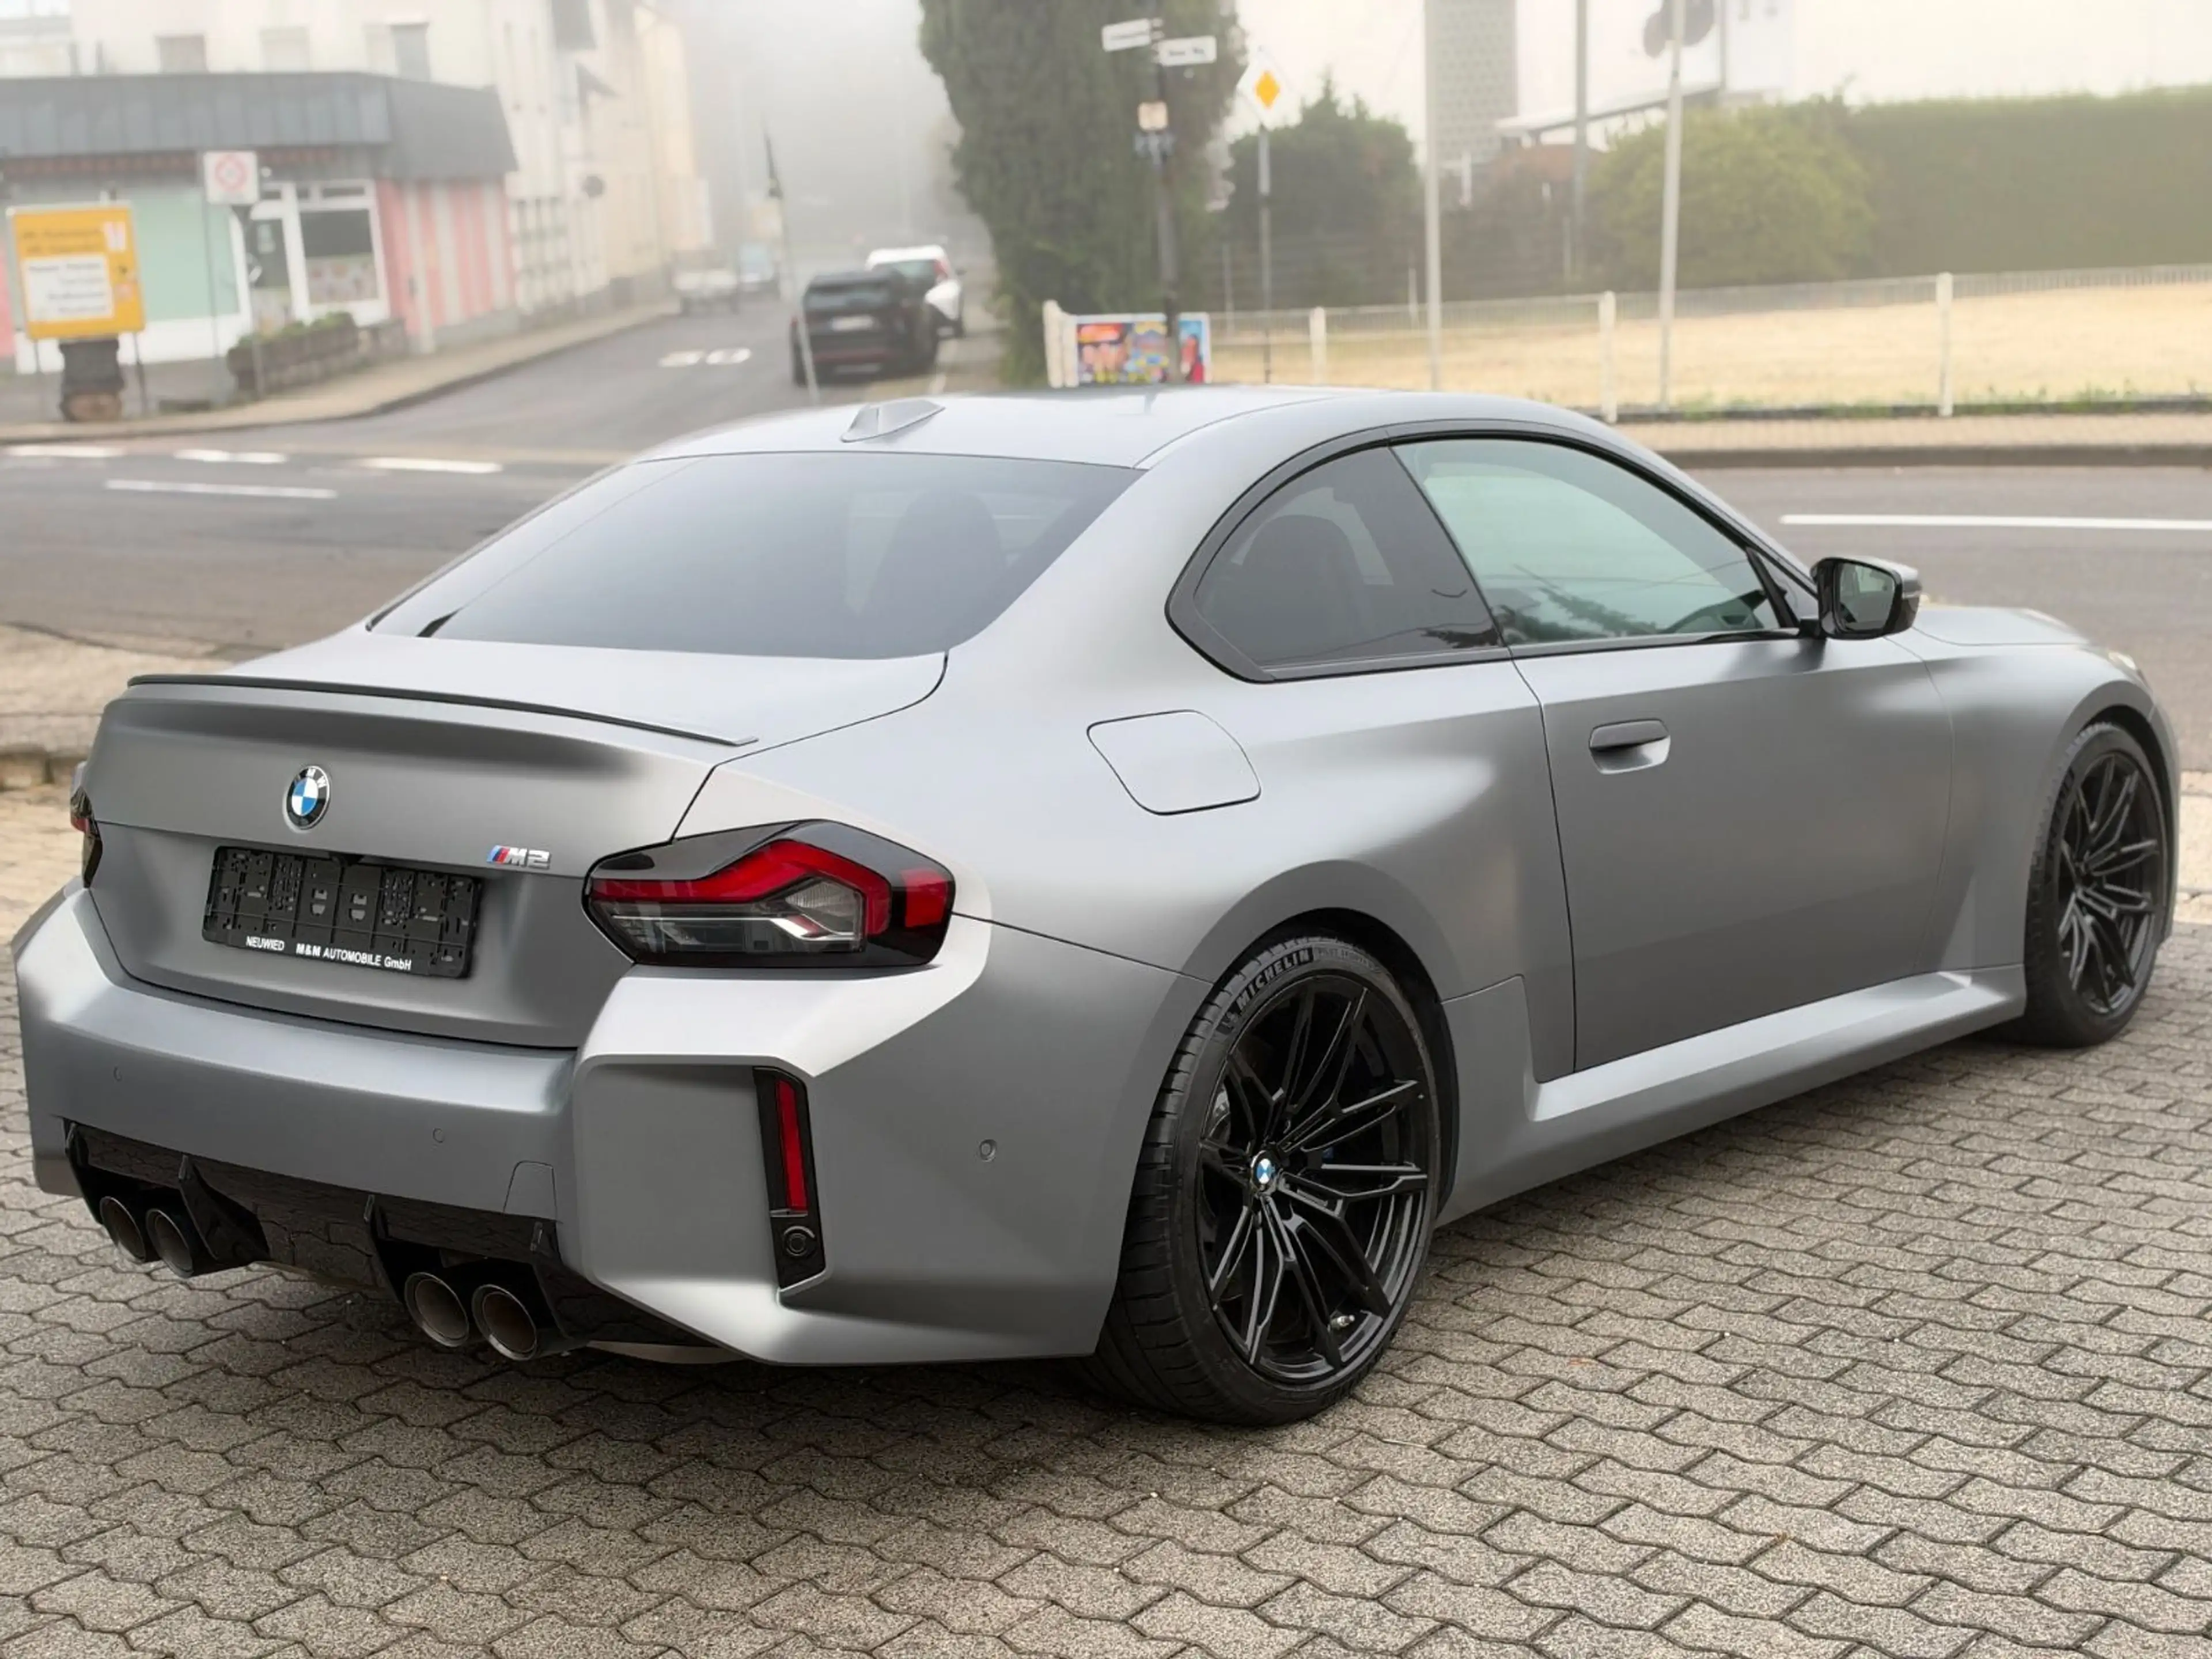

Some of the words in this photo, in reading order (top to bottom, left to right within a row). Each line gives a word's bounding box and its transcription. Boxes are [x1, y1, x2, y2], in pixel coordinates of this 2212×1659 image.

[502, 847, 551, 869] M2
[245, 935, 285, 951] NEUWIED
[296, 942, 320, 957] M&M
[323, 947, 381, 967] AUTOMOBILE
[384, 956, 412, 971] GmbH
[1236, 949, 1310, 1010] MICHELIN
